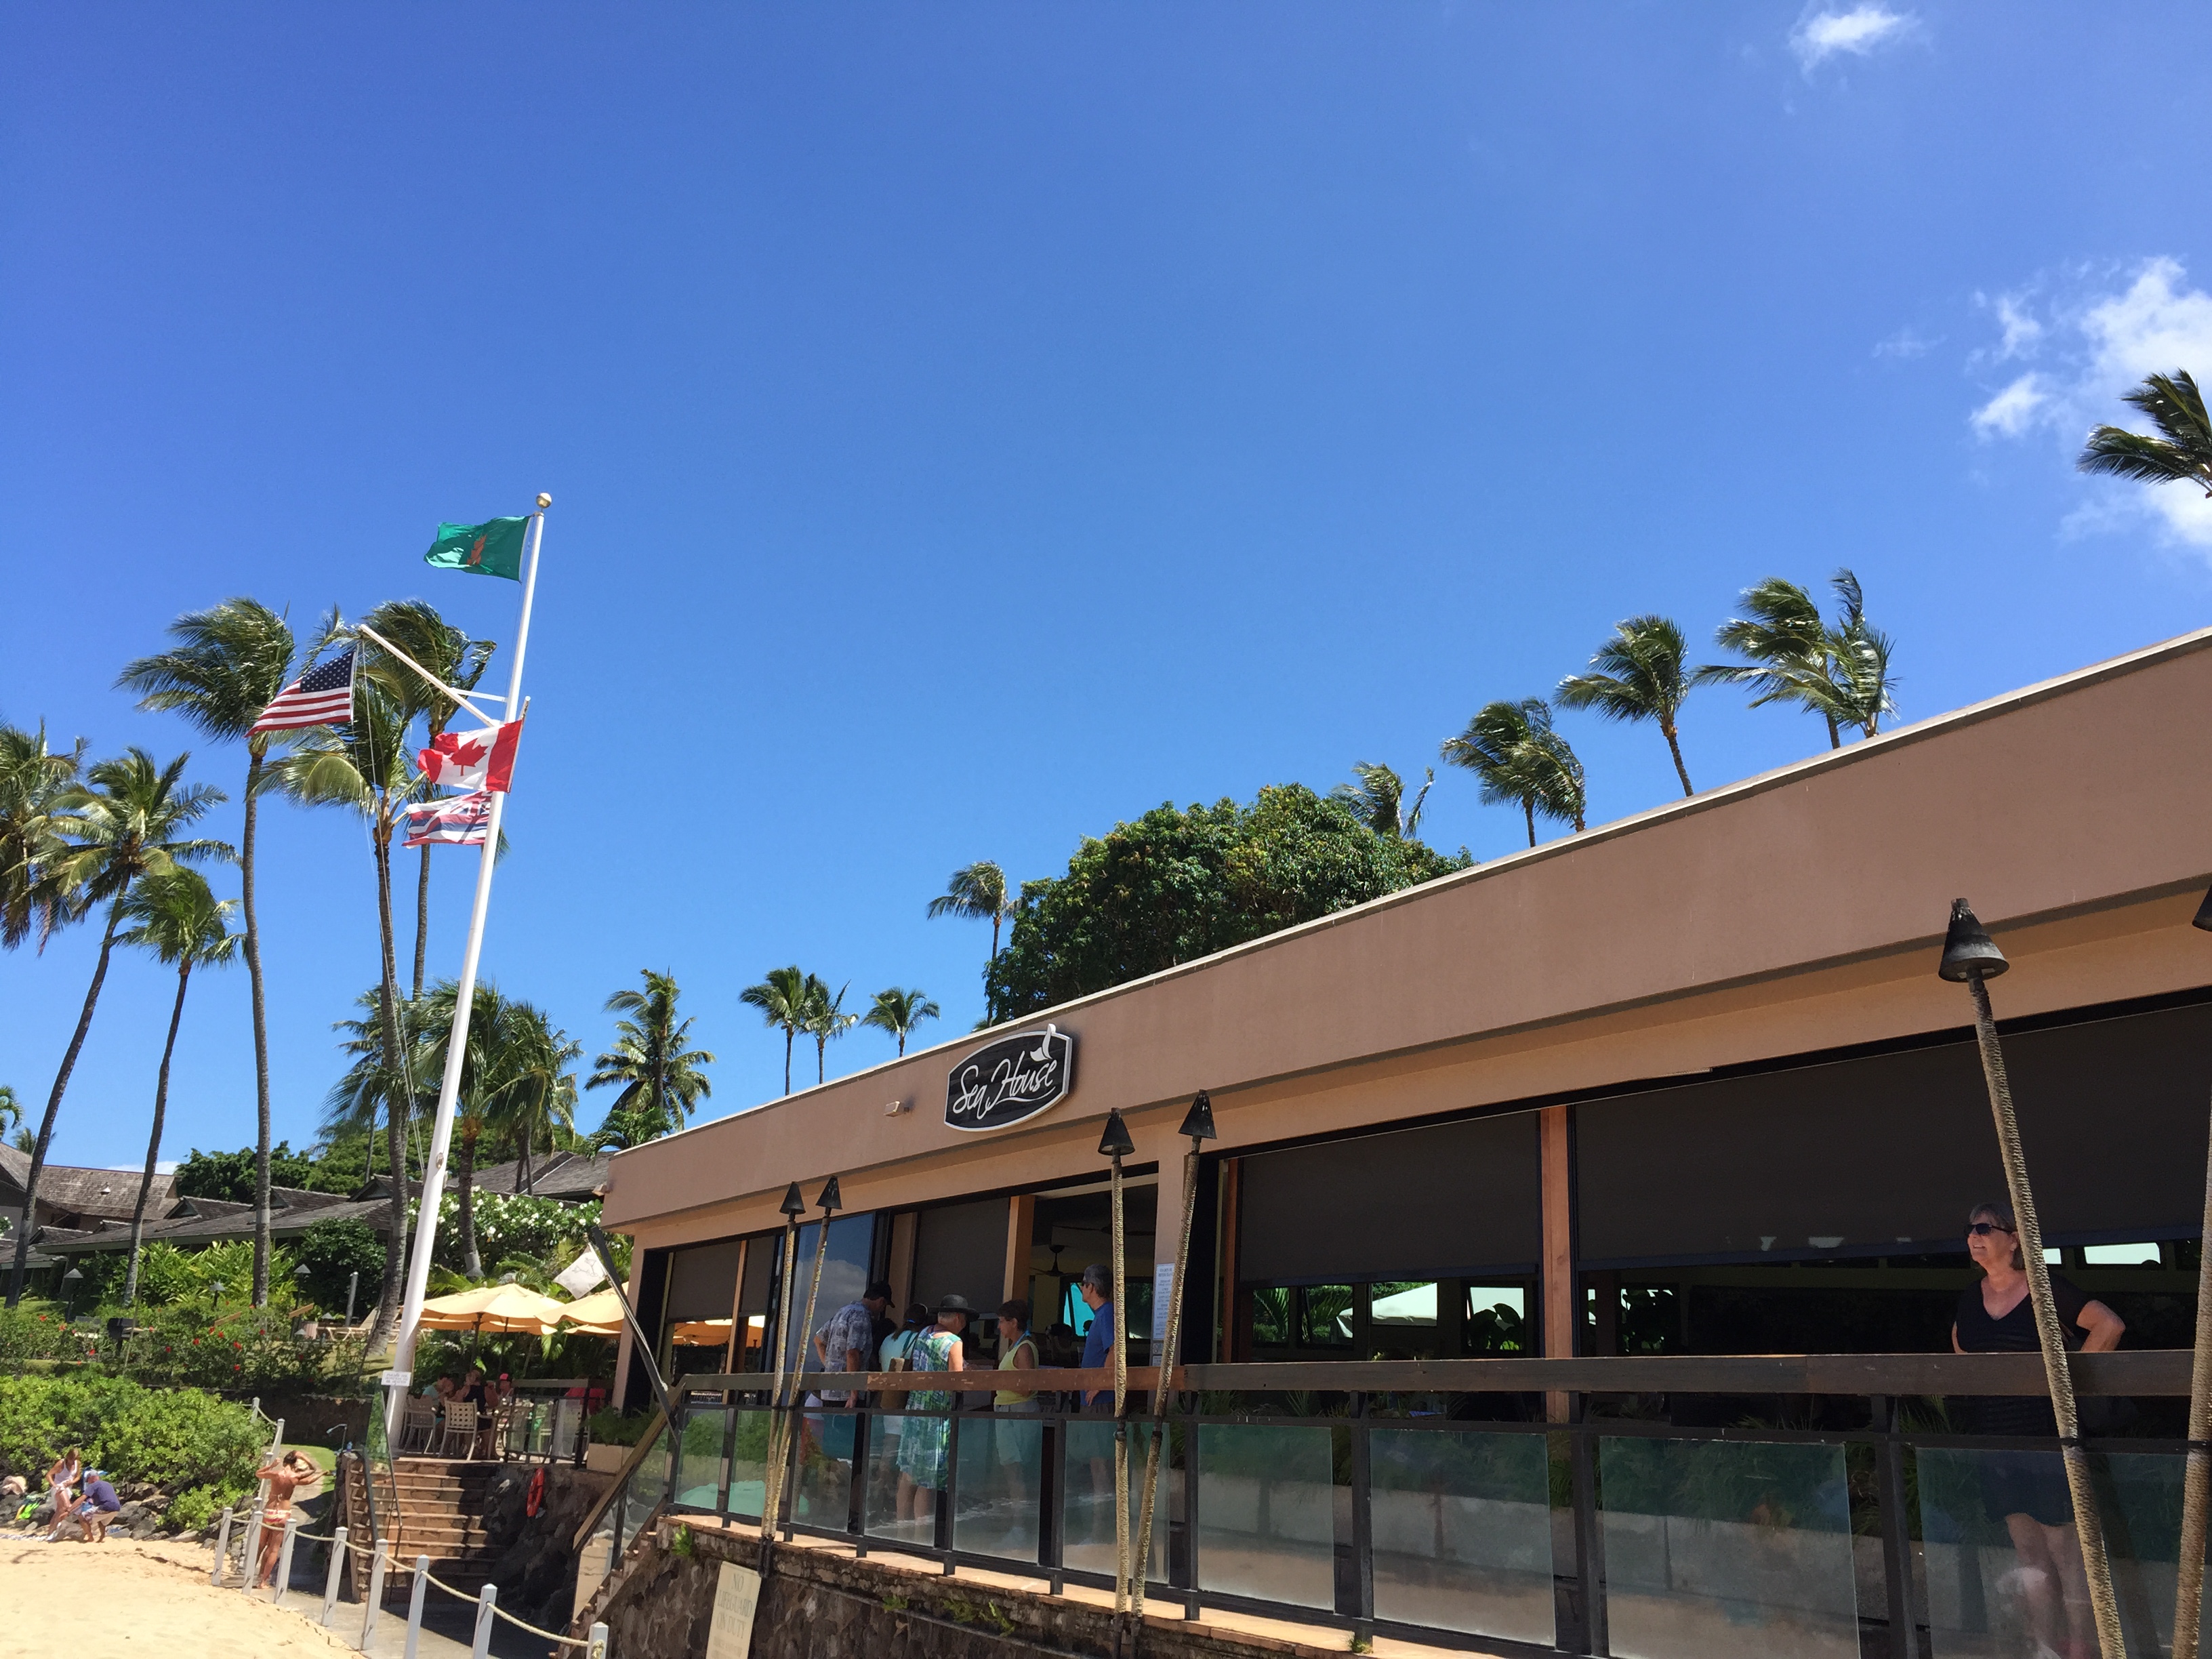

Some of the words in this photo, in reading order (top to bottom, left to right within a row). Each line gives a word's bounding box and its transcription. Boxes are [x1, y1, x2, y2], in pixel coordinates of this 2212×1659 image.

[953, 1065, 988, 1120] Sea
[987, 1050, 1057, 1111] House
[731, 1573, 744, 1593] NO
[717, 1589, 752, 1618] LIFEGUARD
[716, 1612, 727, 1630] ON
[727, 1616, 746, 1639] DUTY
